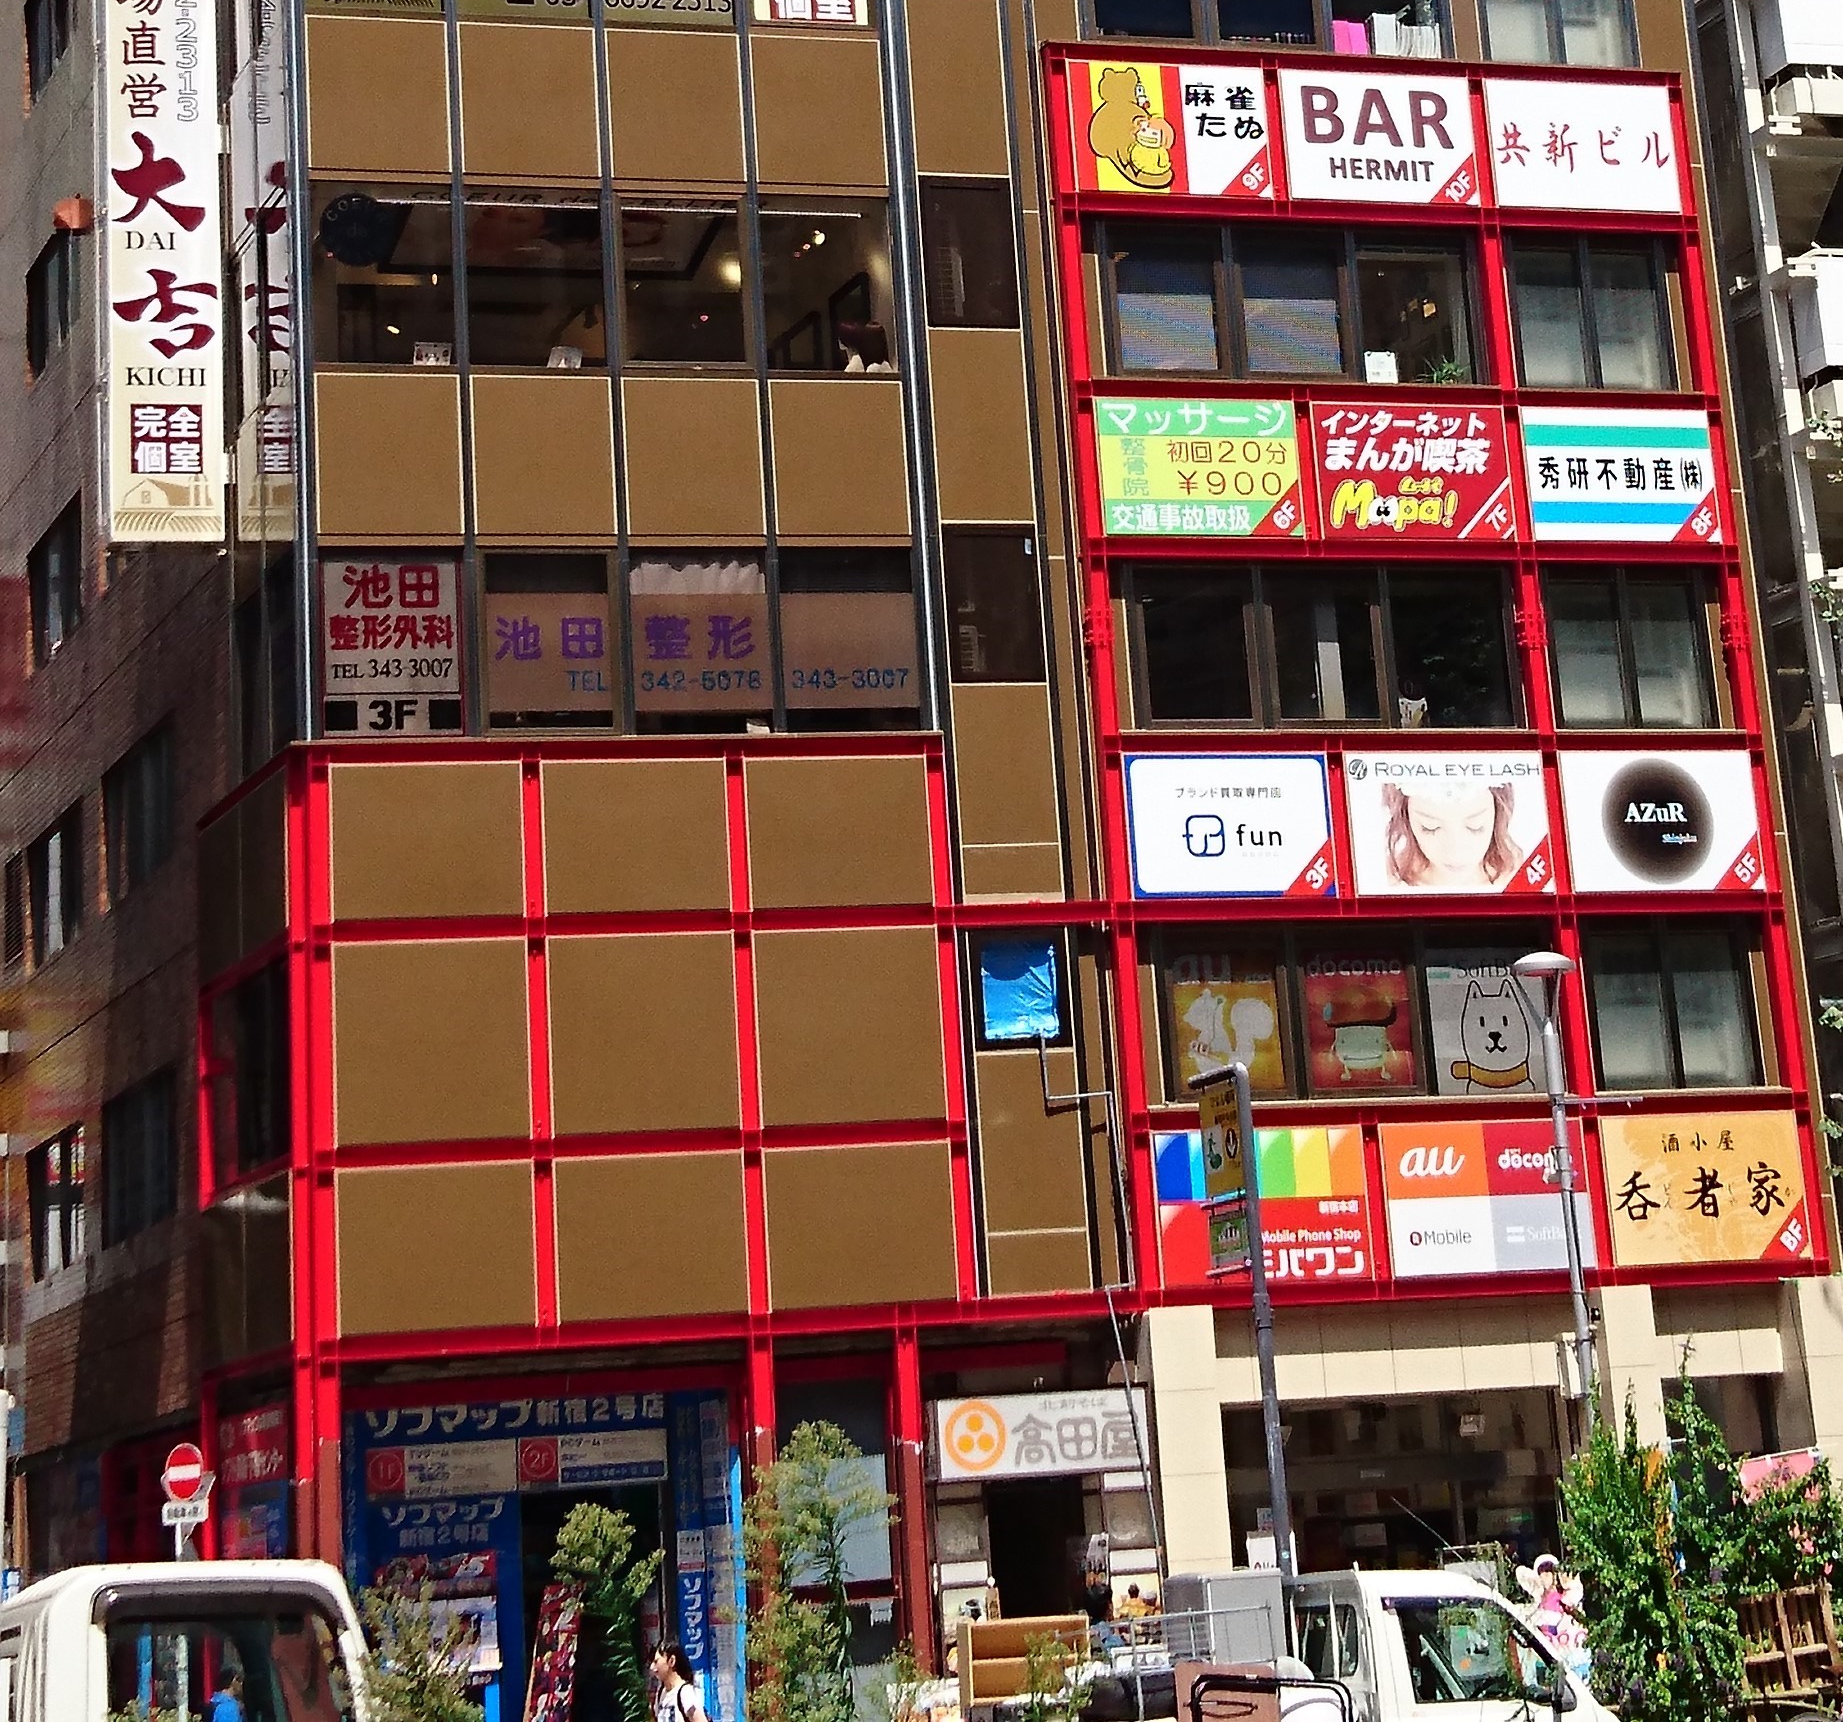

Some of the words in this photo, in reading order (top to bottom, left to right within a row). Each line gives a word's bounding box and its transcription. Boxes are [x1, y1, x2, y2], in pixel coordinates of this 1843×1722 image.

[1184, 81, 1257, 111] 麻雀
[1195, 112, 1265, 139] たぬ
[1300, 85, 1455, 150] BAR
[1495, 121, 1670, 174] 共新ビル
[111, 130, 206, 233] 大
[1241, 161, 1265, 191] 9F
[1329, 156, 1435, 182] HERMIT
[1444, 169, 1472, 203] 10F
[126, 231, 176, 251] DAI
[126, 367, 207, 387] KICHI
[134, 406, 201, 439] 完全
[1101, 401, 1287, 436] マッサージ
[1320, 409, 1487, 438] インターネット
[135, 440, 202, 473] 個室
[1120, 437, 1150, 497] 整骨院
[1324, 436, 1491, 475] まんが喫茶
[1111, 503, 1252, 532] 交通事故取扱
[1273, 499, 1296, 530] 6F
[1483, 502, 1508, 532] 7F
[1691, 506, 1714, 537] 8F
[342, 564, 440, 609] 池田
[329, 614, 454, 651] 整形外科
[331, 664, 365, 679] TEL
[368, 657, 453, 679] 343-3007
[567, 670, 609, 692] TEL
[368, 699, 419, 731] 3F
[1374, 761, 1440, 777] ROYAL
[1445, 763, 1485, 776] EYE
[1489, 763, 1541, 776] LASH
[1235, 823, 1283, 847] fun
[1305, 857, 1329, 890] 3F
[1525, 854, 1547, 885] 4F
[1733, 851, 1757, 884] 5F
[1399, 1145, 1466, 1179] au
[1297, 1228, 1332, 1243] Phone
[1333, 1226, 1361, 1243] Shop
[1424, 1229, 1473, 1246] Mobile
[1779, 1217, 1804, 1253] BF
